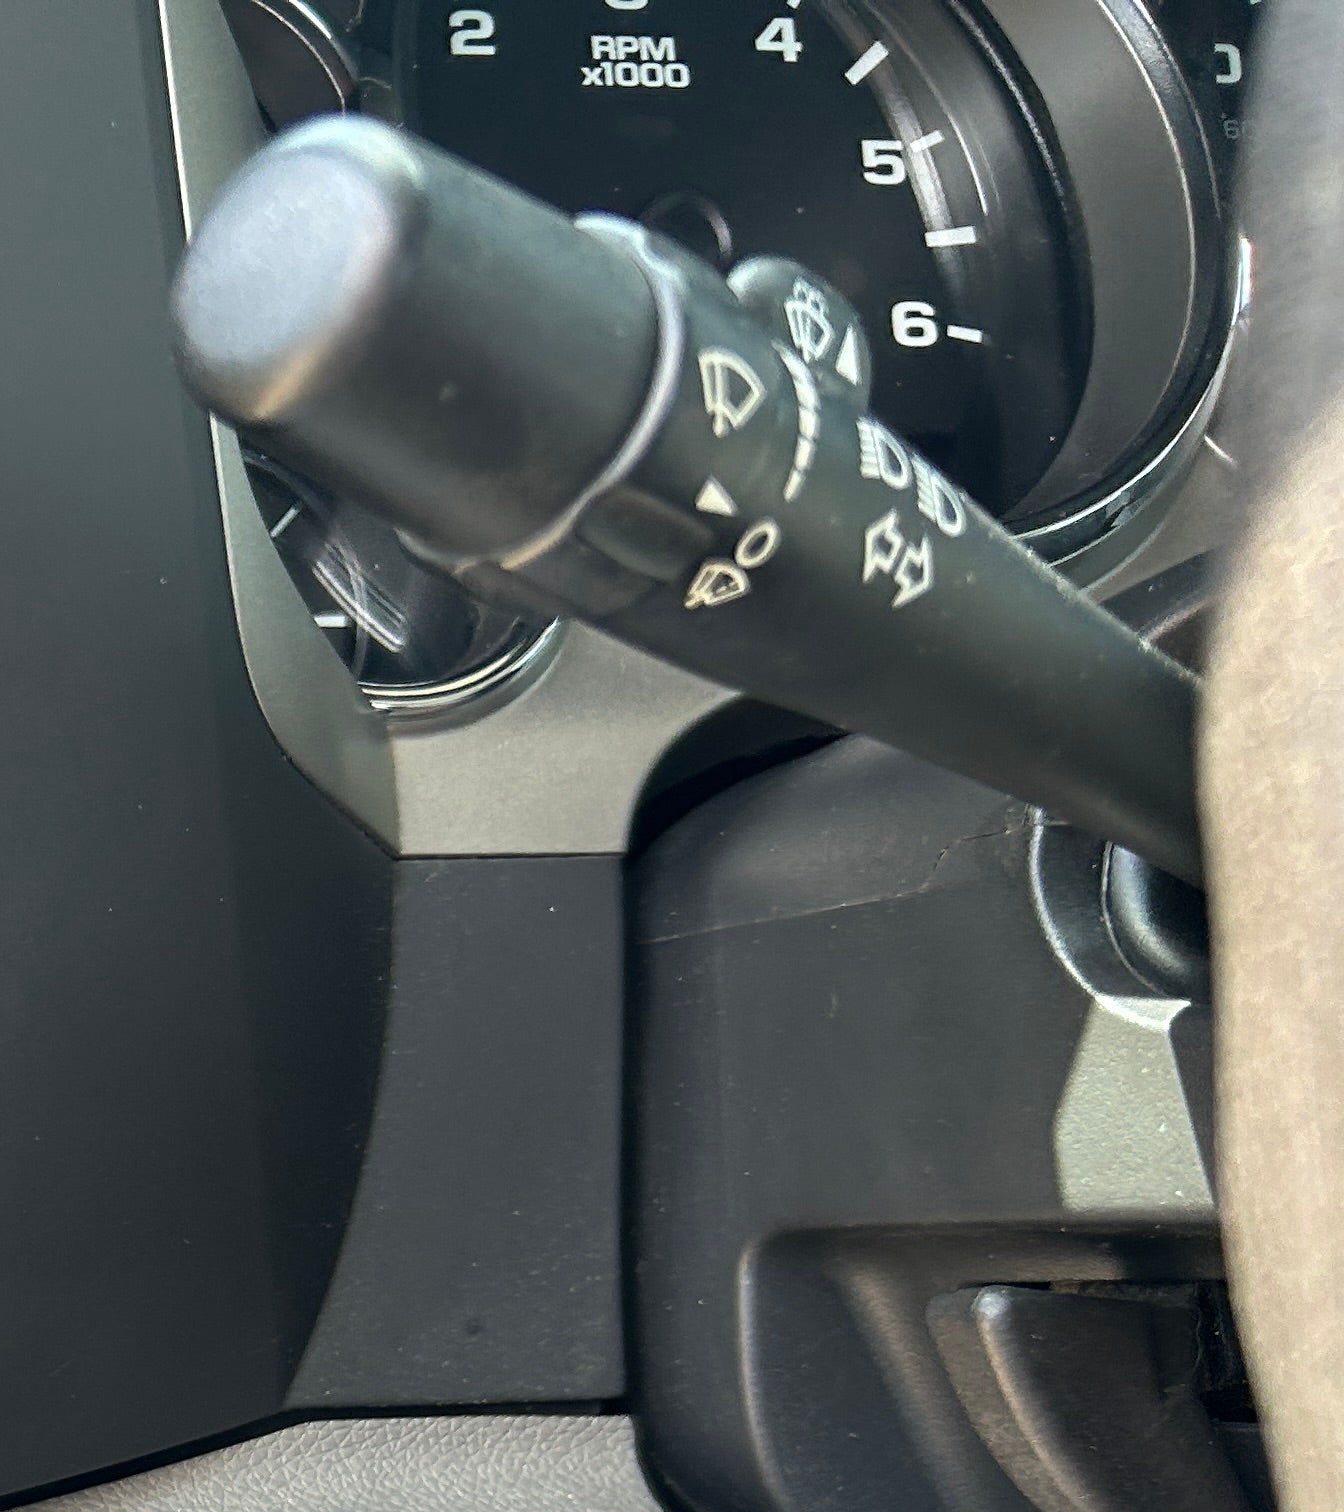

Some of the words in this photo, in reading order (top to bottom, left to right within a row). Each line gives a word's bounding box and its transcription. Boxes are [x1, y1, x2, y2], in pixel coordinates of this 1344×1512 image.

[448, 9, 497, 56] 2
[590, 34, 677, 61] RPM
[754, 17, 803, 63] 4
[580, 61, 691, 88] x1000
[861, 139, 907, 185] 5
[891, 301, 939, 347] 6
